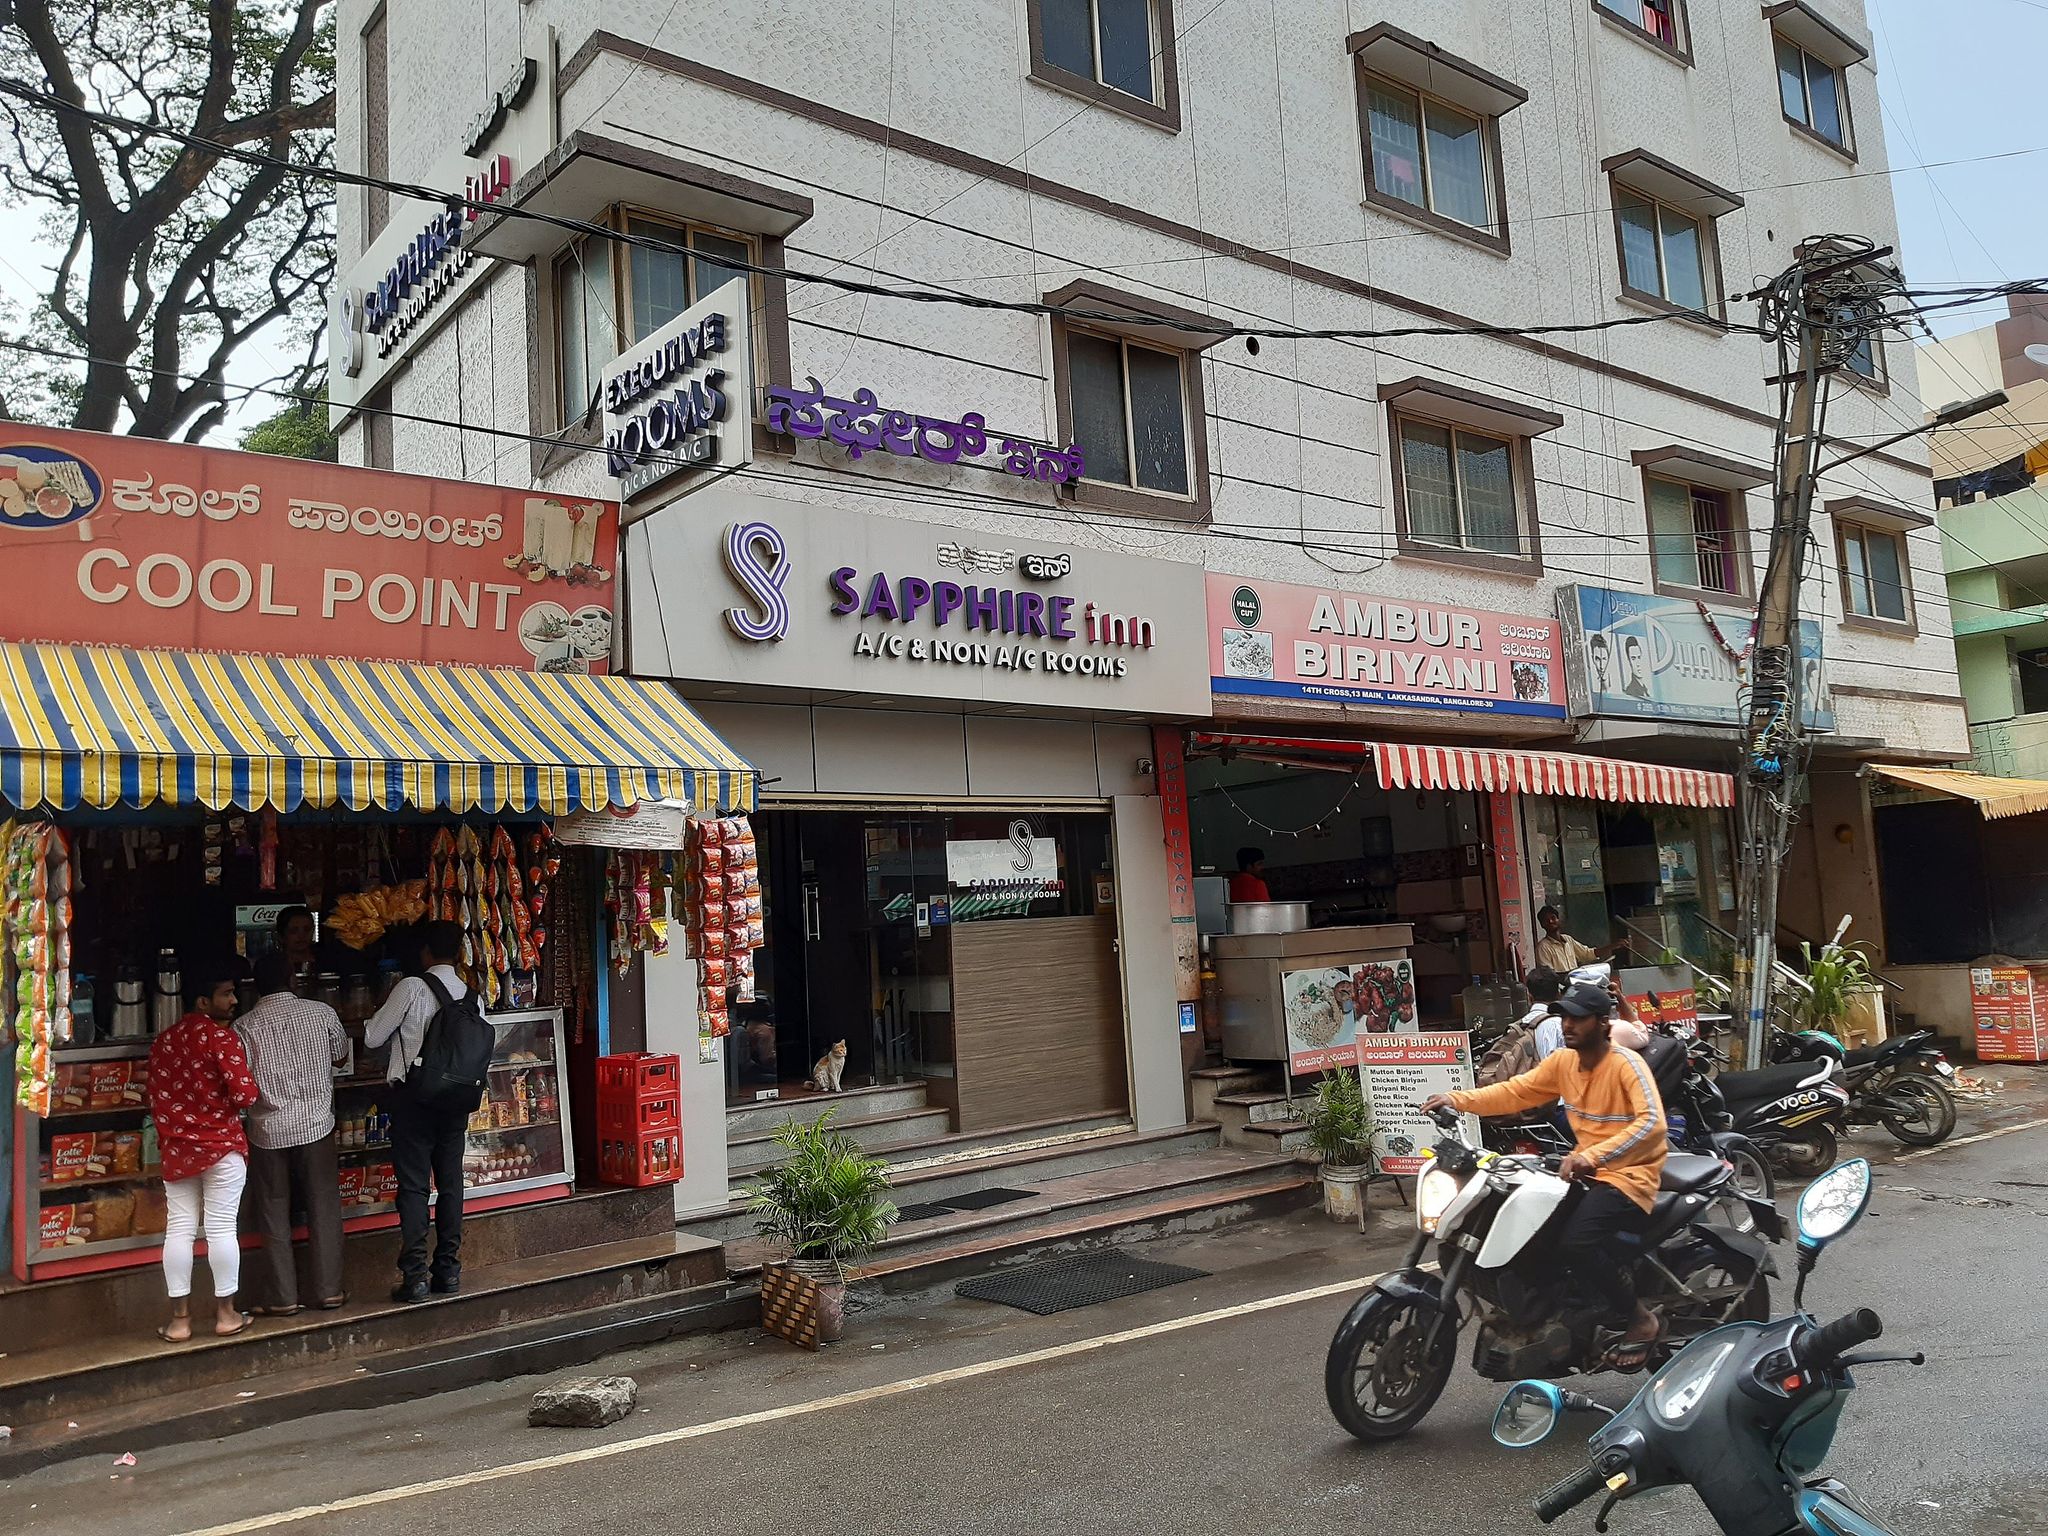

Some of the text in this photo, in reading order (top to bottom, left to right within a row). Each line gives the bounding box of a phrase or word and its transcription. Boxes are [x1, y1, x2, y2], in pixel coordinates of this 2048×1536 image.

[606, 312, 725, 414] EXECUTIVE
[607, 367, 727, 477] ROOMS
[624, 440, 701, 497] A/C & NON A/C
[112, 471, 504, 548] ಕೂಲ್ ಪಾಯಿಂಟ್
[77, 547, 522, 632] COOL POINT
[830, 566, 1157, 648] SAPPHIRE inn
[1236, 600, 1257, 609] HALAL
[1308, 594, 1482, 652] AMBUR
[854, 631, 1129, 678] A/C & NON A/C ROOMS
[1294, 640, 1498, 693] BIRIYANI
[1302, 686, 1322, 695] 14TH
[1362, 691, 1384, 700] MAIN,
[1387, 693, 1442, 705] LAKKASANDRA,
[1443, 697, 1494, 708] BANGALORE-30
[969, 876, 1065, 894] SAPPHIRE inn
[976, 893, 990, 901] A/C
[1019, 891, 1032, 899] A/C
[1034, 890, 1060, 898] ROOMS
[1365, 1037, 1462, 1047] AMBUR BIRIYANI
[1396, 1068, 1423, 1076] Biriyani
[1401, 1077, 1428, 1085] Biriyani
[1776, 1091, 1819, 1110] VOGO
[56, 1148, 82, 1157] Lotte
[56, 1154, 102, 1166] Choco Pie
[40, 1220, 62, 1230] otte
